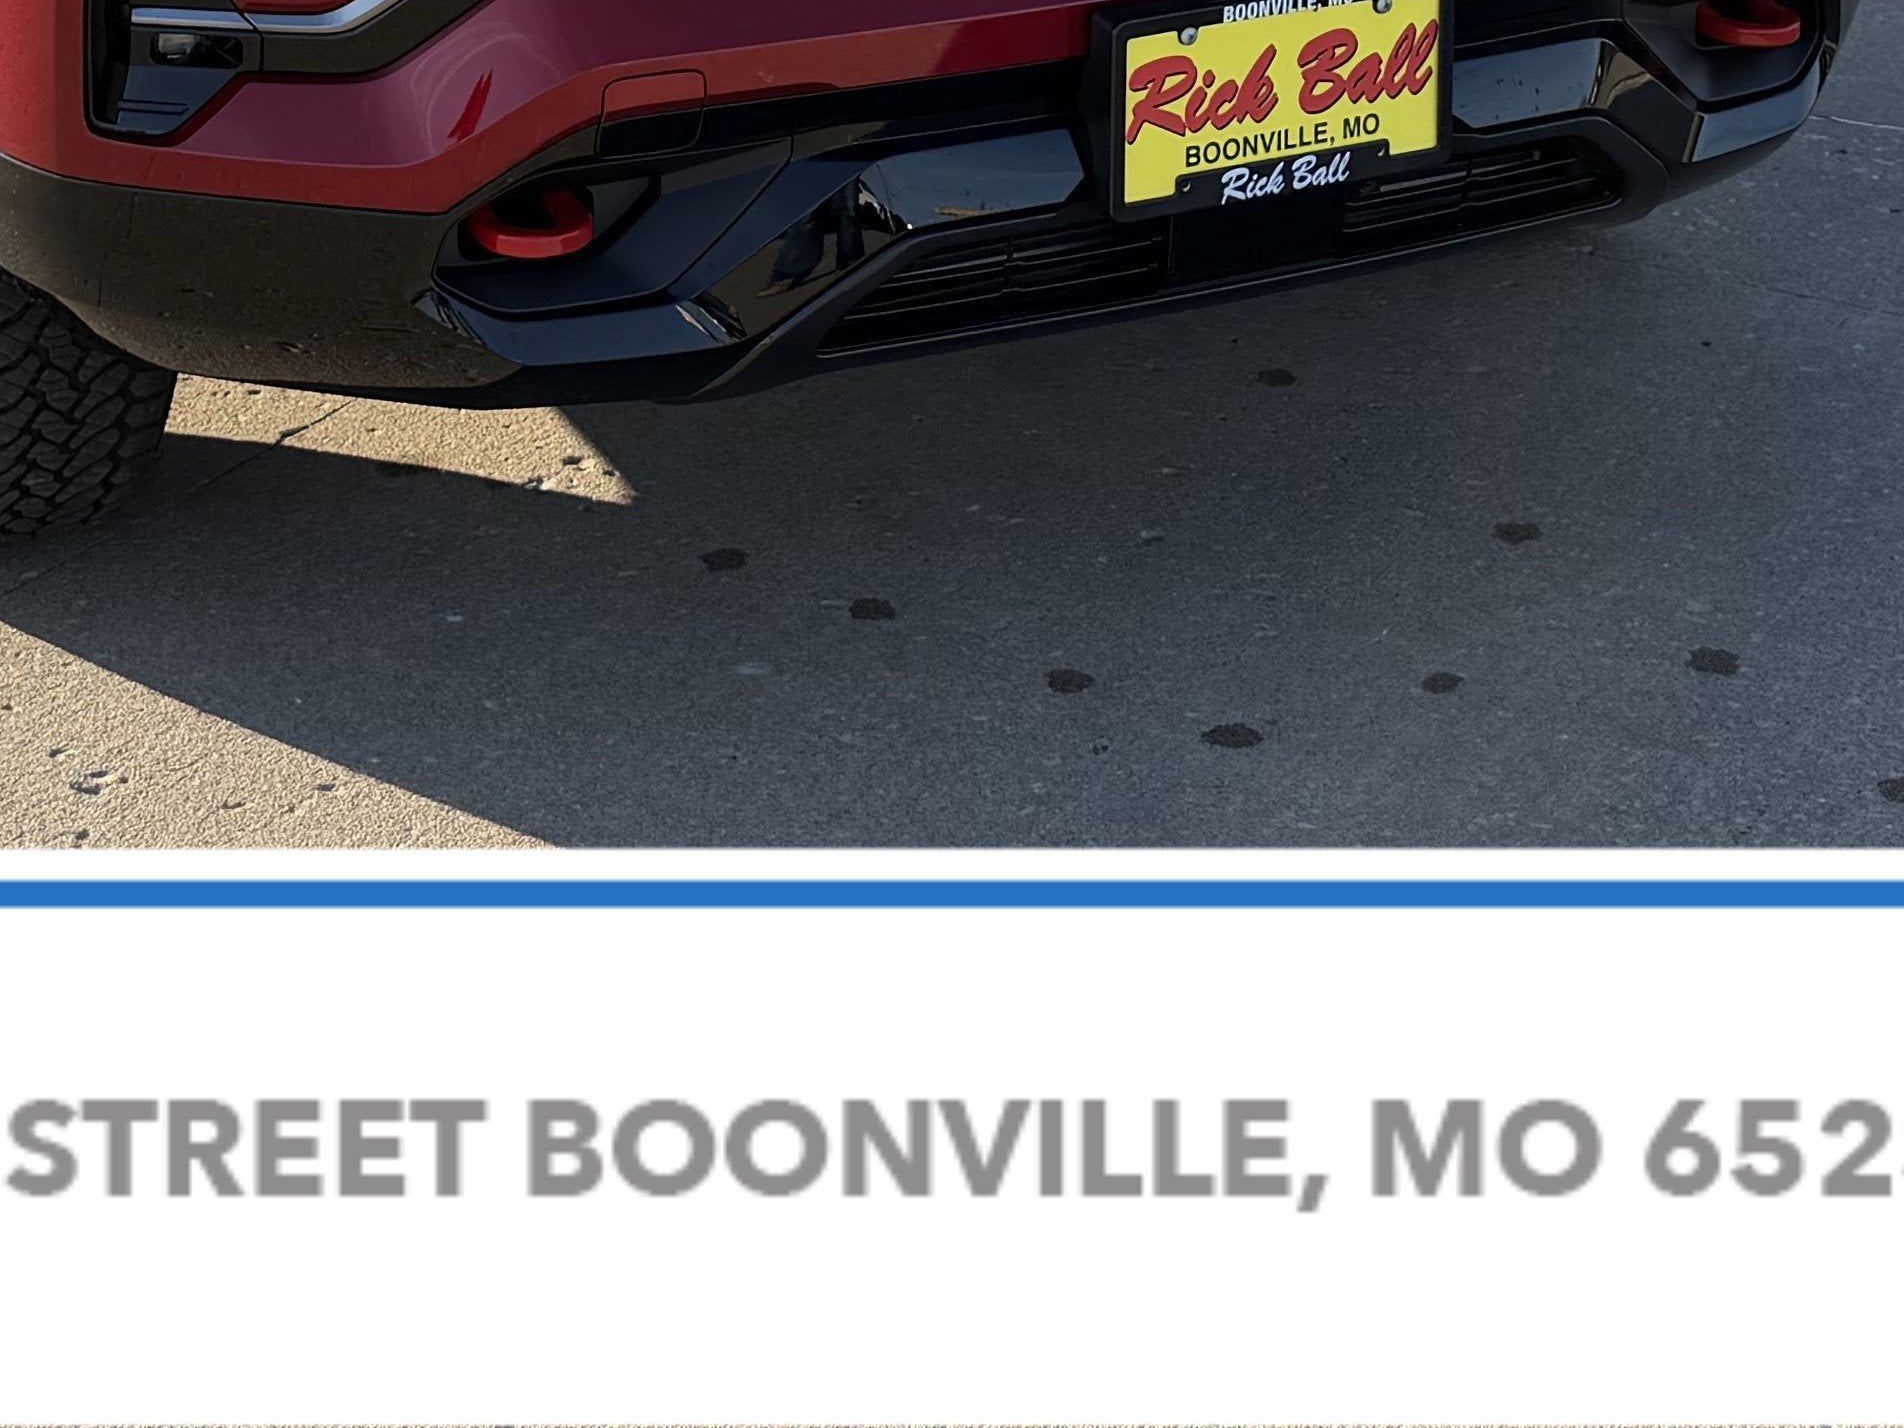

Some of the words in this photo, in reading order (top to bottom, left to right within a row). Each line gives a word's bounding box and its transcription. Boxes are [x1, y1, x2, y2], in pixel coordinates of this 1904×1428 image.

[1126, 44, 1279, 145] Rick
[1297, 18, 1440, 115] Ball
[1185, 121, 1336, 168] BOONVILLE,
[1342, 112, 1381, 139] MO
[1221, 161, 1285, 205] Rick
[1291, 152, 1350, 191] Ball
